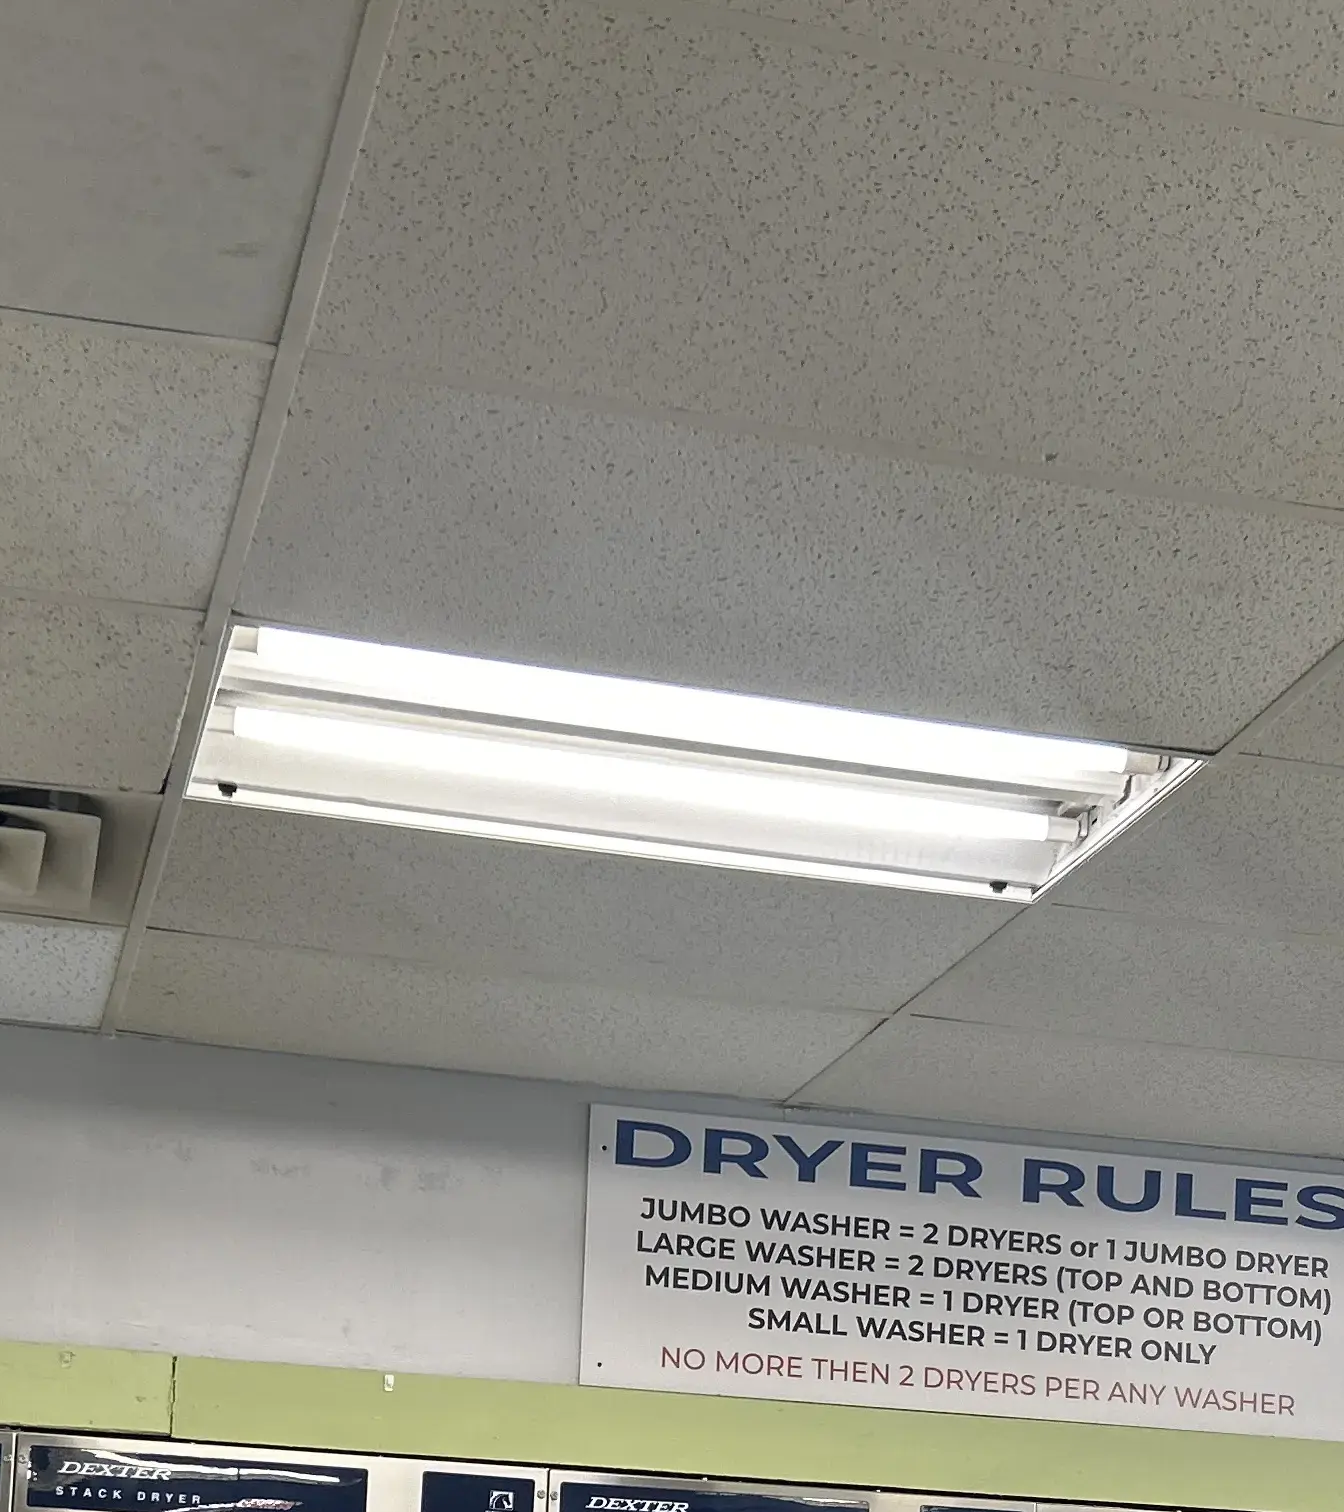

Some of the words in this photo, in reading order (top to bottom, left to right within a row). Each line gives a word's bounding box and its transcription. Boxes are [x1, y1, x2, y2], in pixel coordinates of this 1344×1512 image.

[614, 1118, 983, 1199] DRYER
[637, 1230, 736, 1261] LARGE
[744, 1239, 876, 1273] WASHER
[908, 1254, 924, 1277] 2
[933, 1256, 1048, 1287] DRYERS
[1056, 1265, 1123, 1294] (TOP
[1130, 1274, 1194, 1298] AND
[1203, 1279, 1331, 1316] BOTTOM)
[640, 1197, 751, 1228] JUMBO
[759, 1207, 891, 1241] WASHER
[922, 1222, 939, 1245] 2
[948, 1224, 1062, 1256] DRYERS
[1069, 1240, 1099, 1259] or
[1106, 1238, 1116, 1260] 1
[1123, 1240, 1227, 1269] JUMBO
[1236, 1250, 1329, 1278] DRYER
[645, 1264, 771, 1297] MEDIUM
[780, 1276, 911, 1309] WASHER
[942, 1289, 953, 1312] 1
[962, 1291, 1060, 1321] DRYER
[1068, 1299, 1135, 1327] (TOP
[1143, 1307, 1184, 1331] OR
[1193, 1311, 1322, 1347] BOTTOM)
[748, 1307, 848, 1337] SMALL
[855, 1315, 985, 1348] WASHER
[1016, 1329, 1027, 1351] 1
[1036, 1330, 1132, 1359] DRYER
[1141, 1339, 1217, 1365] ONLY
[661, 1346, 706, 1371] NO
[716, 1350, 803, 1379] MORE
[810, 1357, 890, 1385] THEN
[899, 1364, 915, 1387] 2
[924, 1366, 1036, 1396] DRYERS
[1045, 1376, 1100, 1401] PER
[1107, 1381, 1167, 1406] ANY
[1174, 1386, 1295, 1416] WASHER
[56, 1486, 123, 1501] STACK
[137, 1490, 202, 1505] DRYER
[58, 1460, 173, 1482] DEXTER
